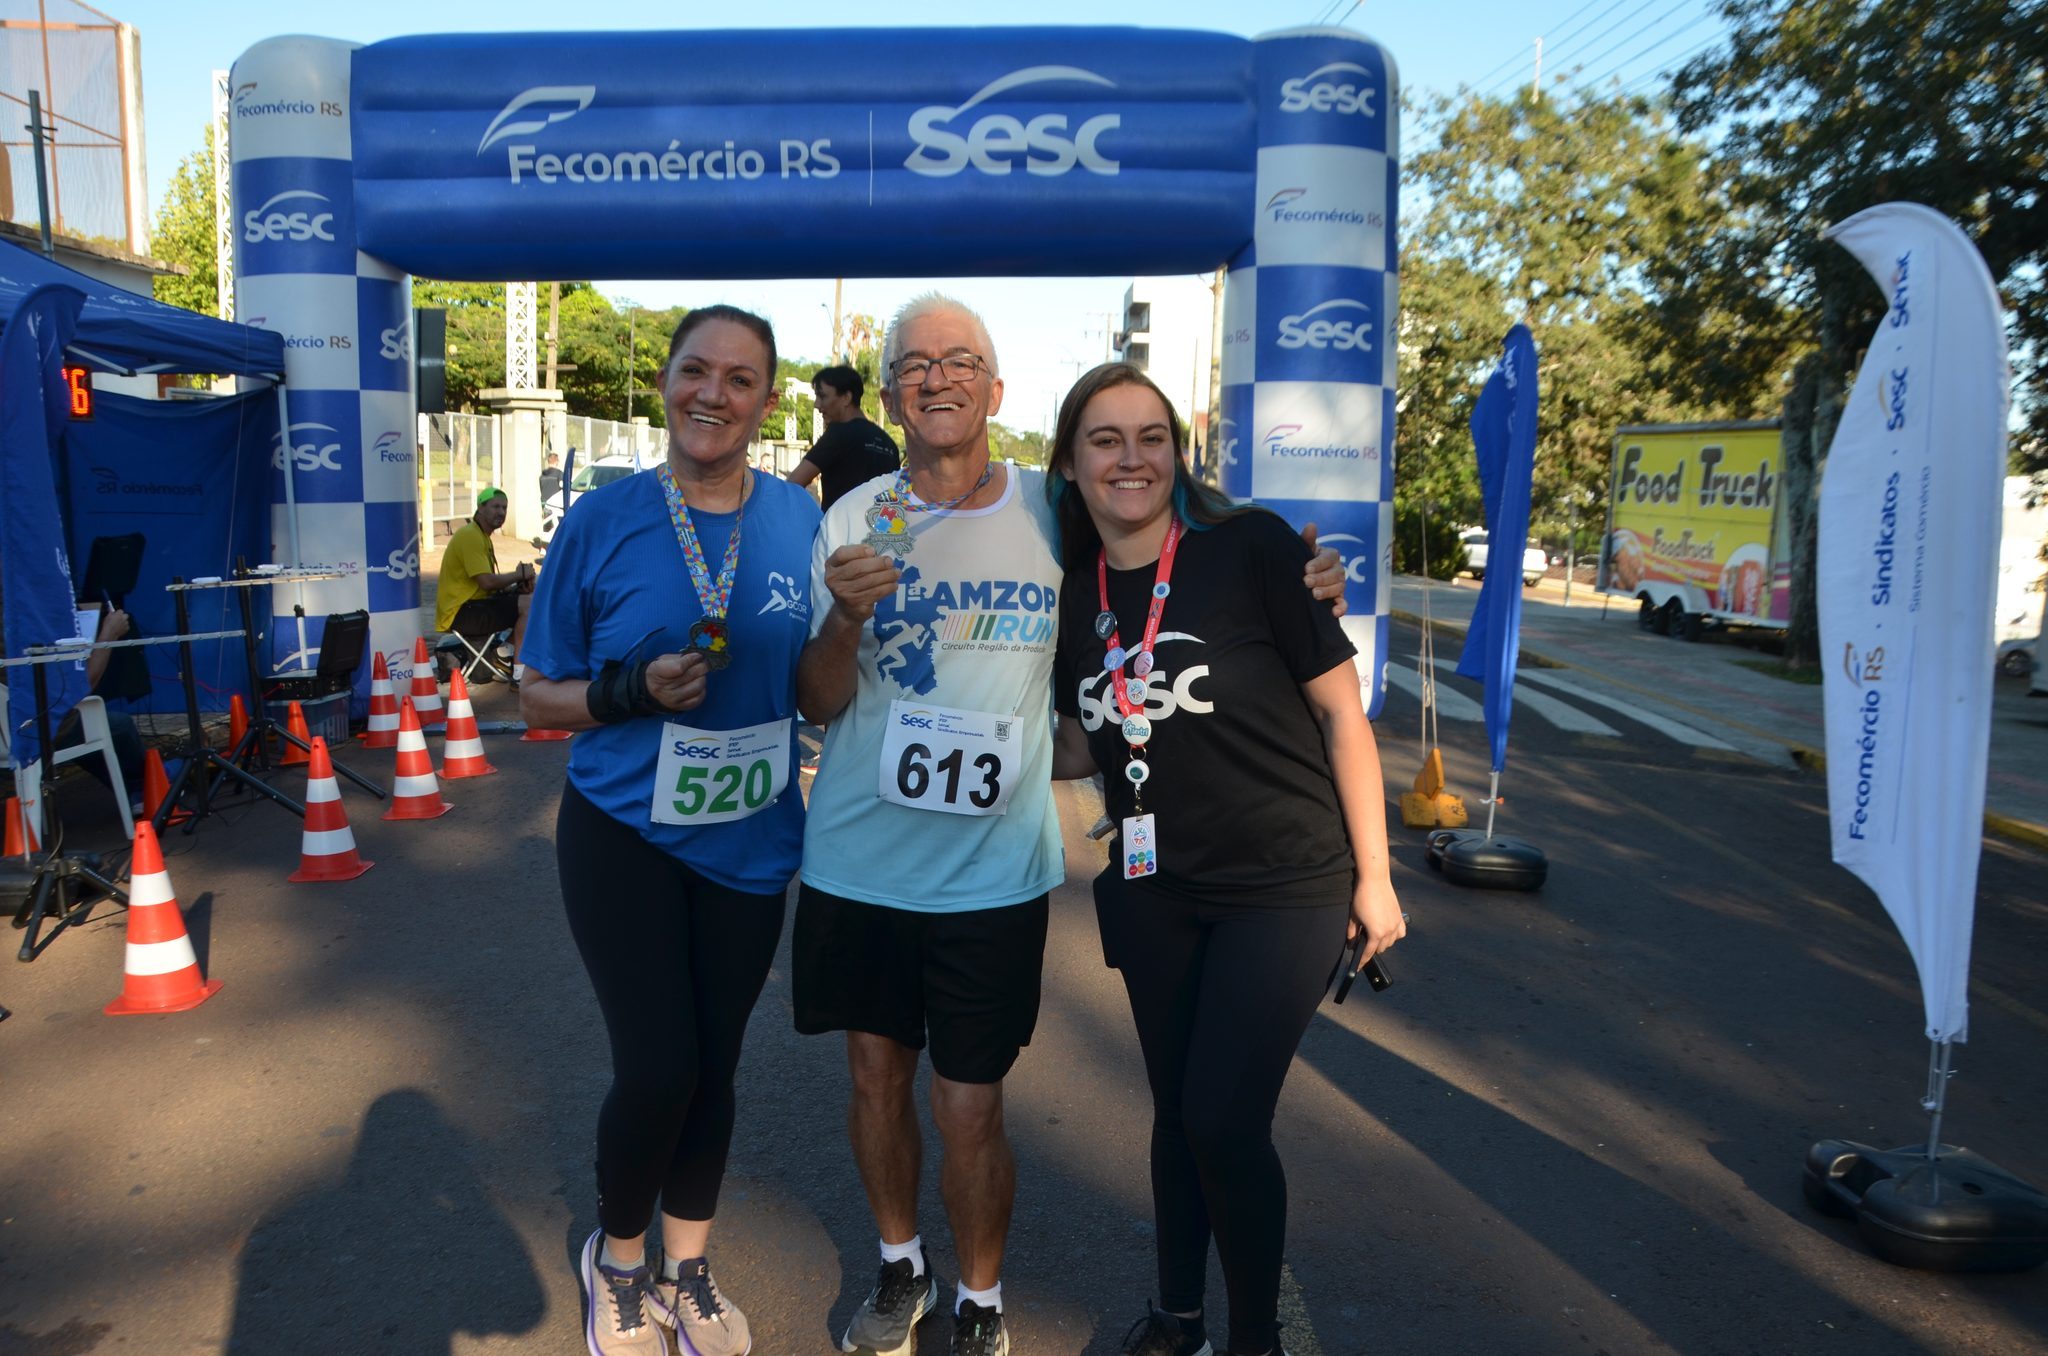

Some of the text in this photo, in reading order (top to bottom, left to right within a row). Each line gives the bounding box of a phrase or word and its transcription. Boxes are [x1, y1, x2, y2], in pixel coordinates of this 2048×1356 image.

[237, 99, 343, 118] Fecomércio RS
[1279, 77, 1376, 119] Sesc
[903, 105, 1121, 177] Sesc
[508, 138, 840, 184] Fecomércio RS
[244, 209, 336, 243] Sesc
[1274, 207, 1383, 229] Fecomércio RS
[283, 335, 352, 350] ércio RS
[379, 328, 412, 361] Se
[1276, 314, 1373, 352] Sesc
[1887, 365, 1910, 431] Sesc
[272, 443, 342, 471] esc
[380, 450, 413, 463] Fecom
[1271, 443, 1359, 460] Fecomércio
[1362, 446, 1378, 461] RS
[1618, 443, 1775, 508] Food Truck
[1872, 470, 1900, 607] Sindicatos
[388, 549, 421, 580] Se
[931, 580, 1057, 614] AMZOP
[992, 614, 1057, 644] RUN
[941, 642, 975, 651] Circuito
[978, 642, 1009, 653] Região
[1011, 643, 1021, 652] da
[1863, 645, 1885, 681] RS
[900, 713, 933, 730] Sesc
[672, 740, 721, 760] Sesc
[1849, 689, 1881, 840] Fecomércio
[672, 758, 773, 816] 520
[897, 742, 1002, 809] 613
